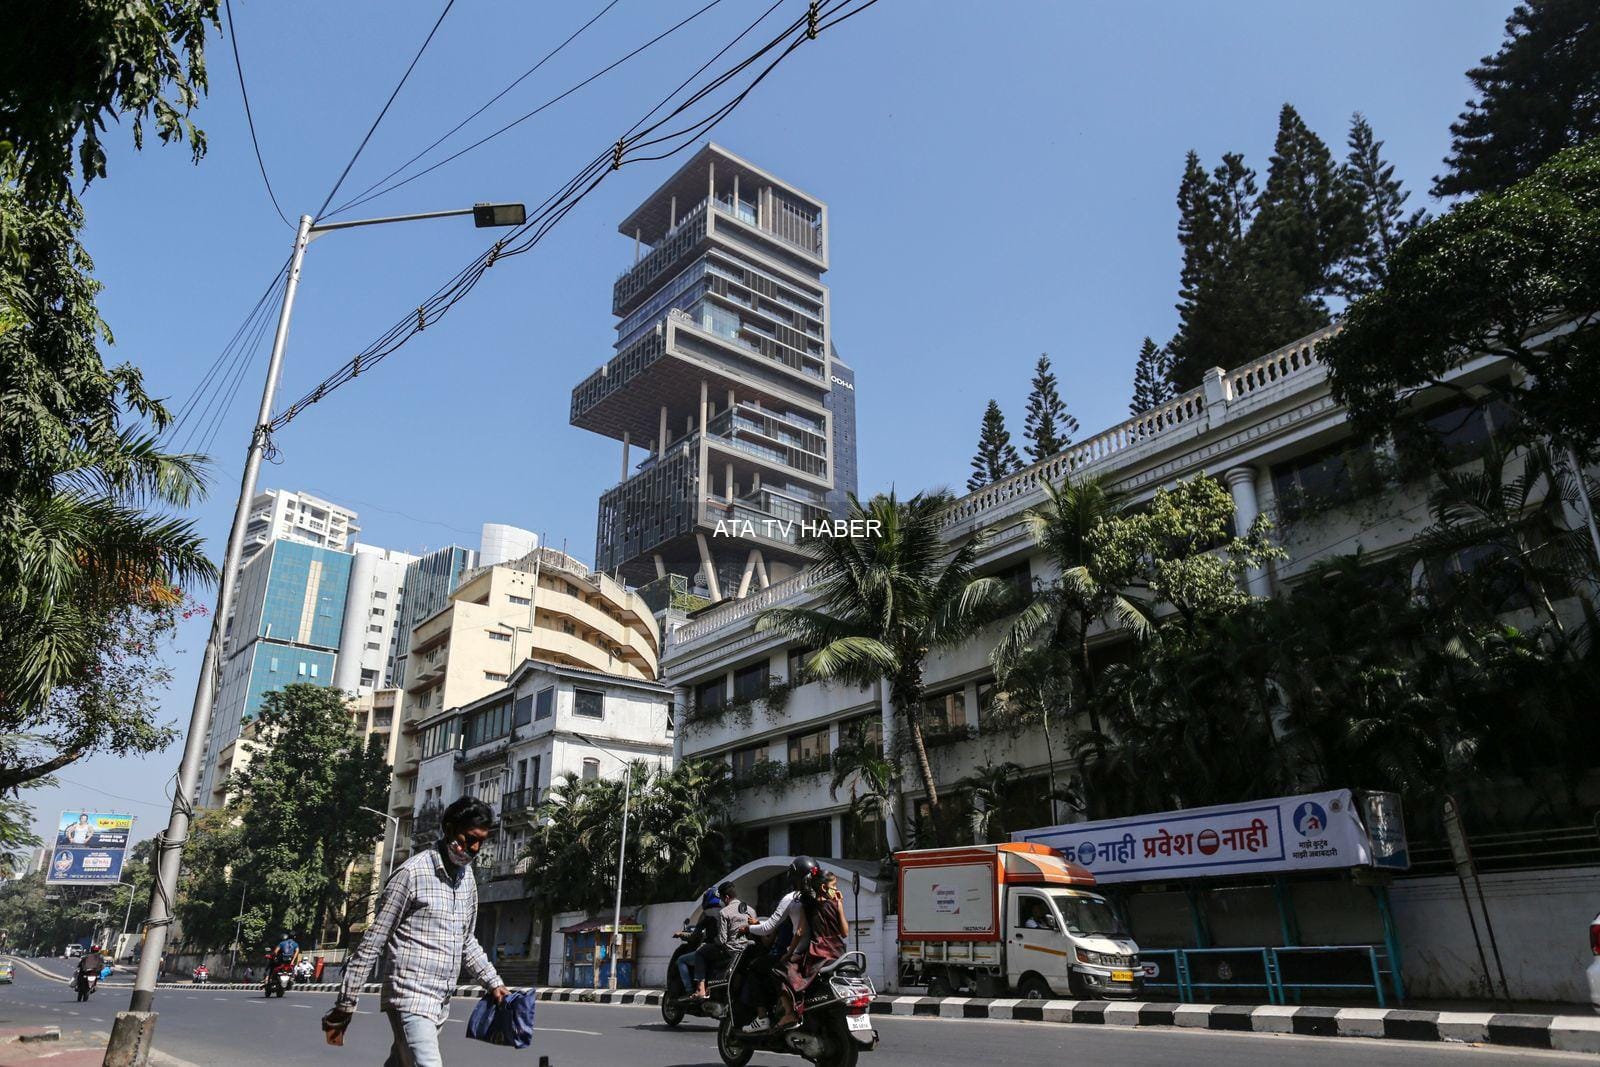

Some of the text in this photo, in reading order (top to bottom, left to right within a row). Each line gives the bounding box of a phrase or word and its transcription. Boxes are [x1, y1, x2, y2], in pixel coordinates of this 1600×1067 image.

[1098, 833, 1136, 863] नाही
[1143, 829, 1193, 858] प्रवेश
[1222, 818, 1268, 852] नाही
